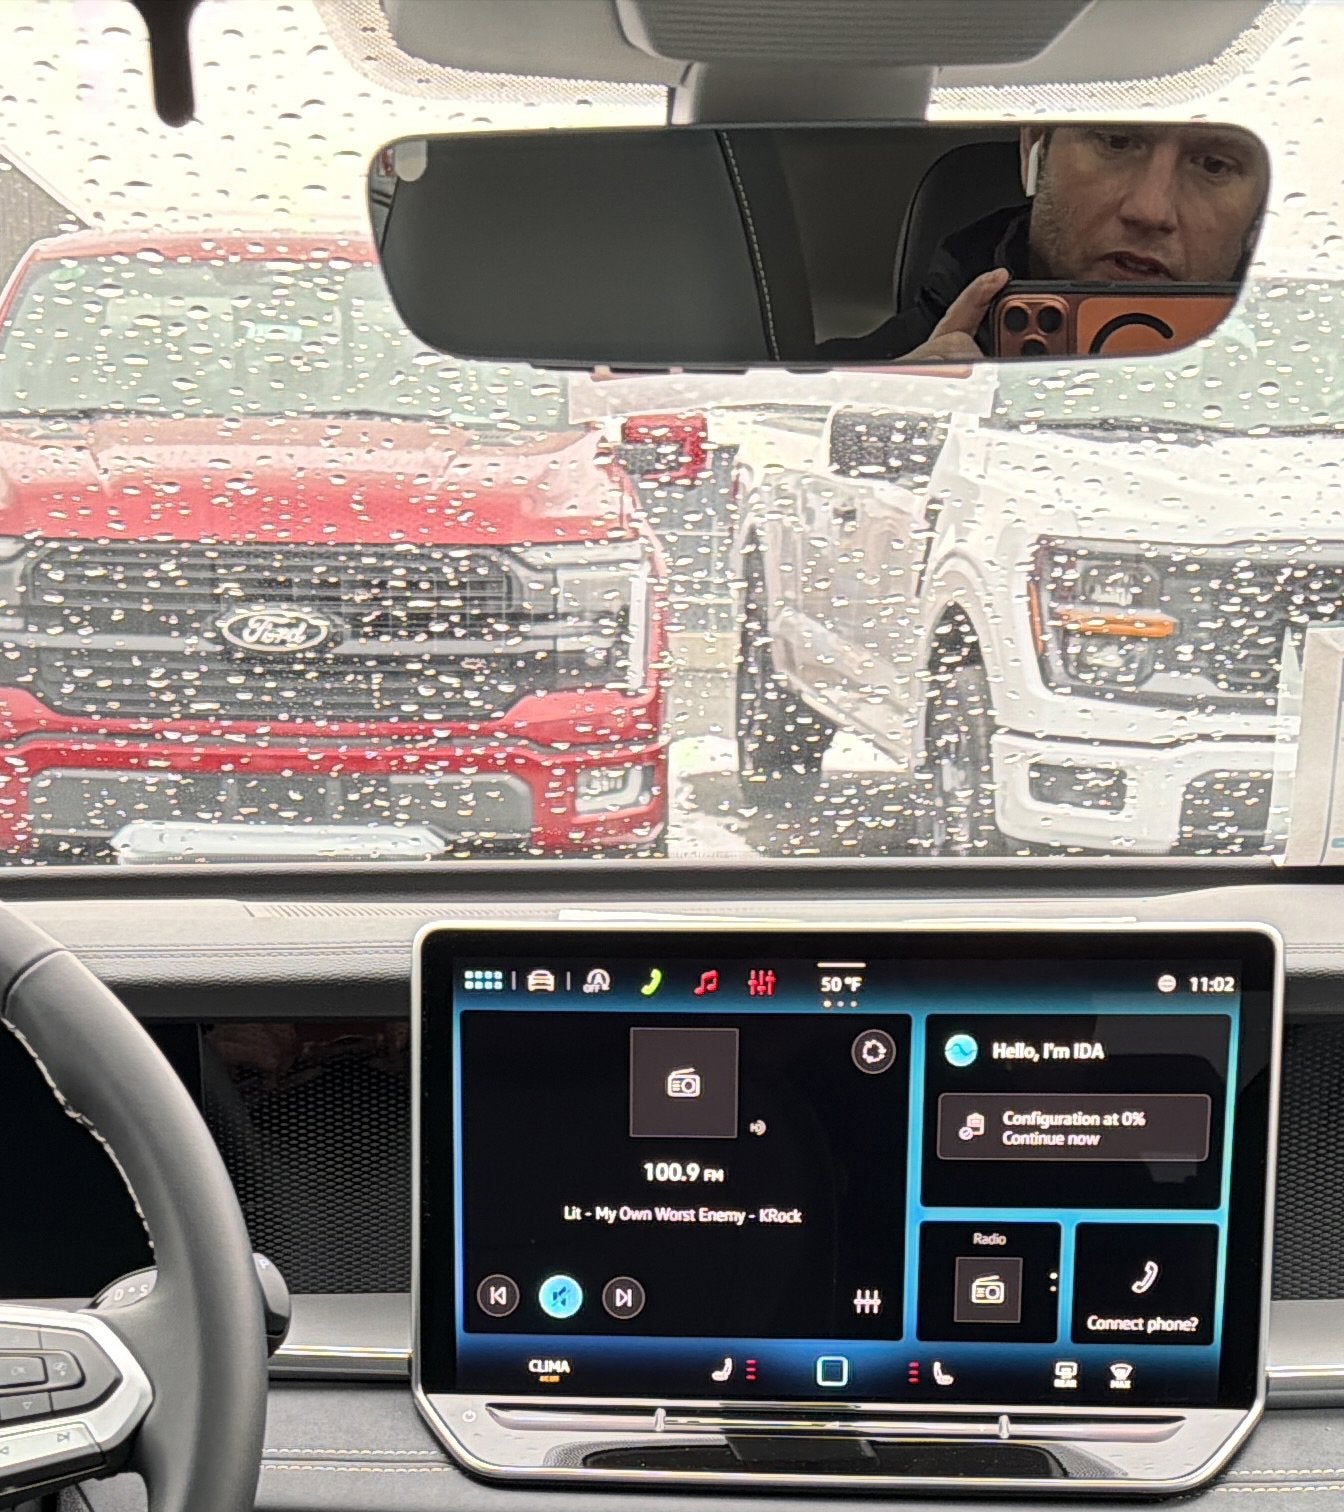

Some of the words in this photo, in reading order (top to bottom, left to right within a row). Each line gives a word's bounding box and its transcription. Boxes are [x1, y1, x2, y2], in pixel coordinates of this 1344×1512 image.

[242, 615, 308, 643] Ford
[820, 976, 841, 992] 50
[844, 976, 863, 992] °F
[1189, 976, 1235, 992] 11:02
[992, 1041, 1040, 1063] Hello,
[1042, 1042, 1071, 1060] I'm
[1073, 1042, 1106, 1060] IDA
[1002, 1110, 1101, 1130] Configuration
[1102, 1112, 1120, 1127] at
[1121, 1111, 1147, 1127] 0%
[1002, 1130, 1065, 1147] Continue
[1067, 1133, 1102, 1147] now
[642, 1162, 701, 1182] 100.9
[703, 1168, 725, 1183] FM
[563, 1205, 582, 1221] Lit
[595, 1206, 617, 1225] My
[619, 1206, 653, 1221] Own
[654, 1206, 697, 1223] Worst
[698, 1207, 746, 1226] Enemy
[972, 1232, 1007, 1246] Radio
[113, 1288, 125, 1301] D
[138, 1284, 149, 1297] S
[1086, 1315, 1145, 1332] Connect
[1146, 1316, 1199, 1334] phone?
[528, 1358, 571, 1374] CLIMA
